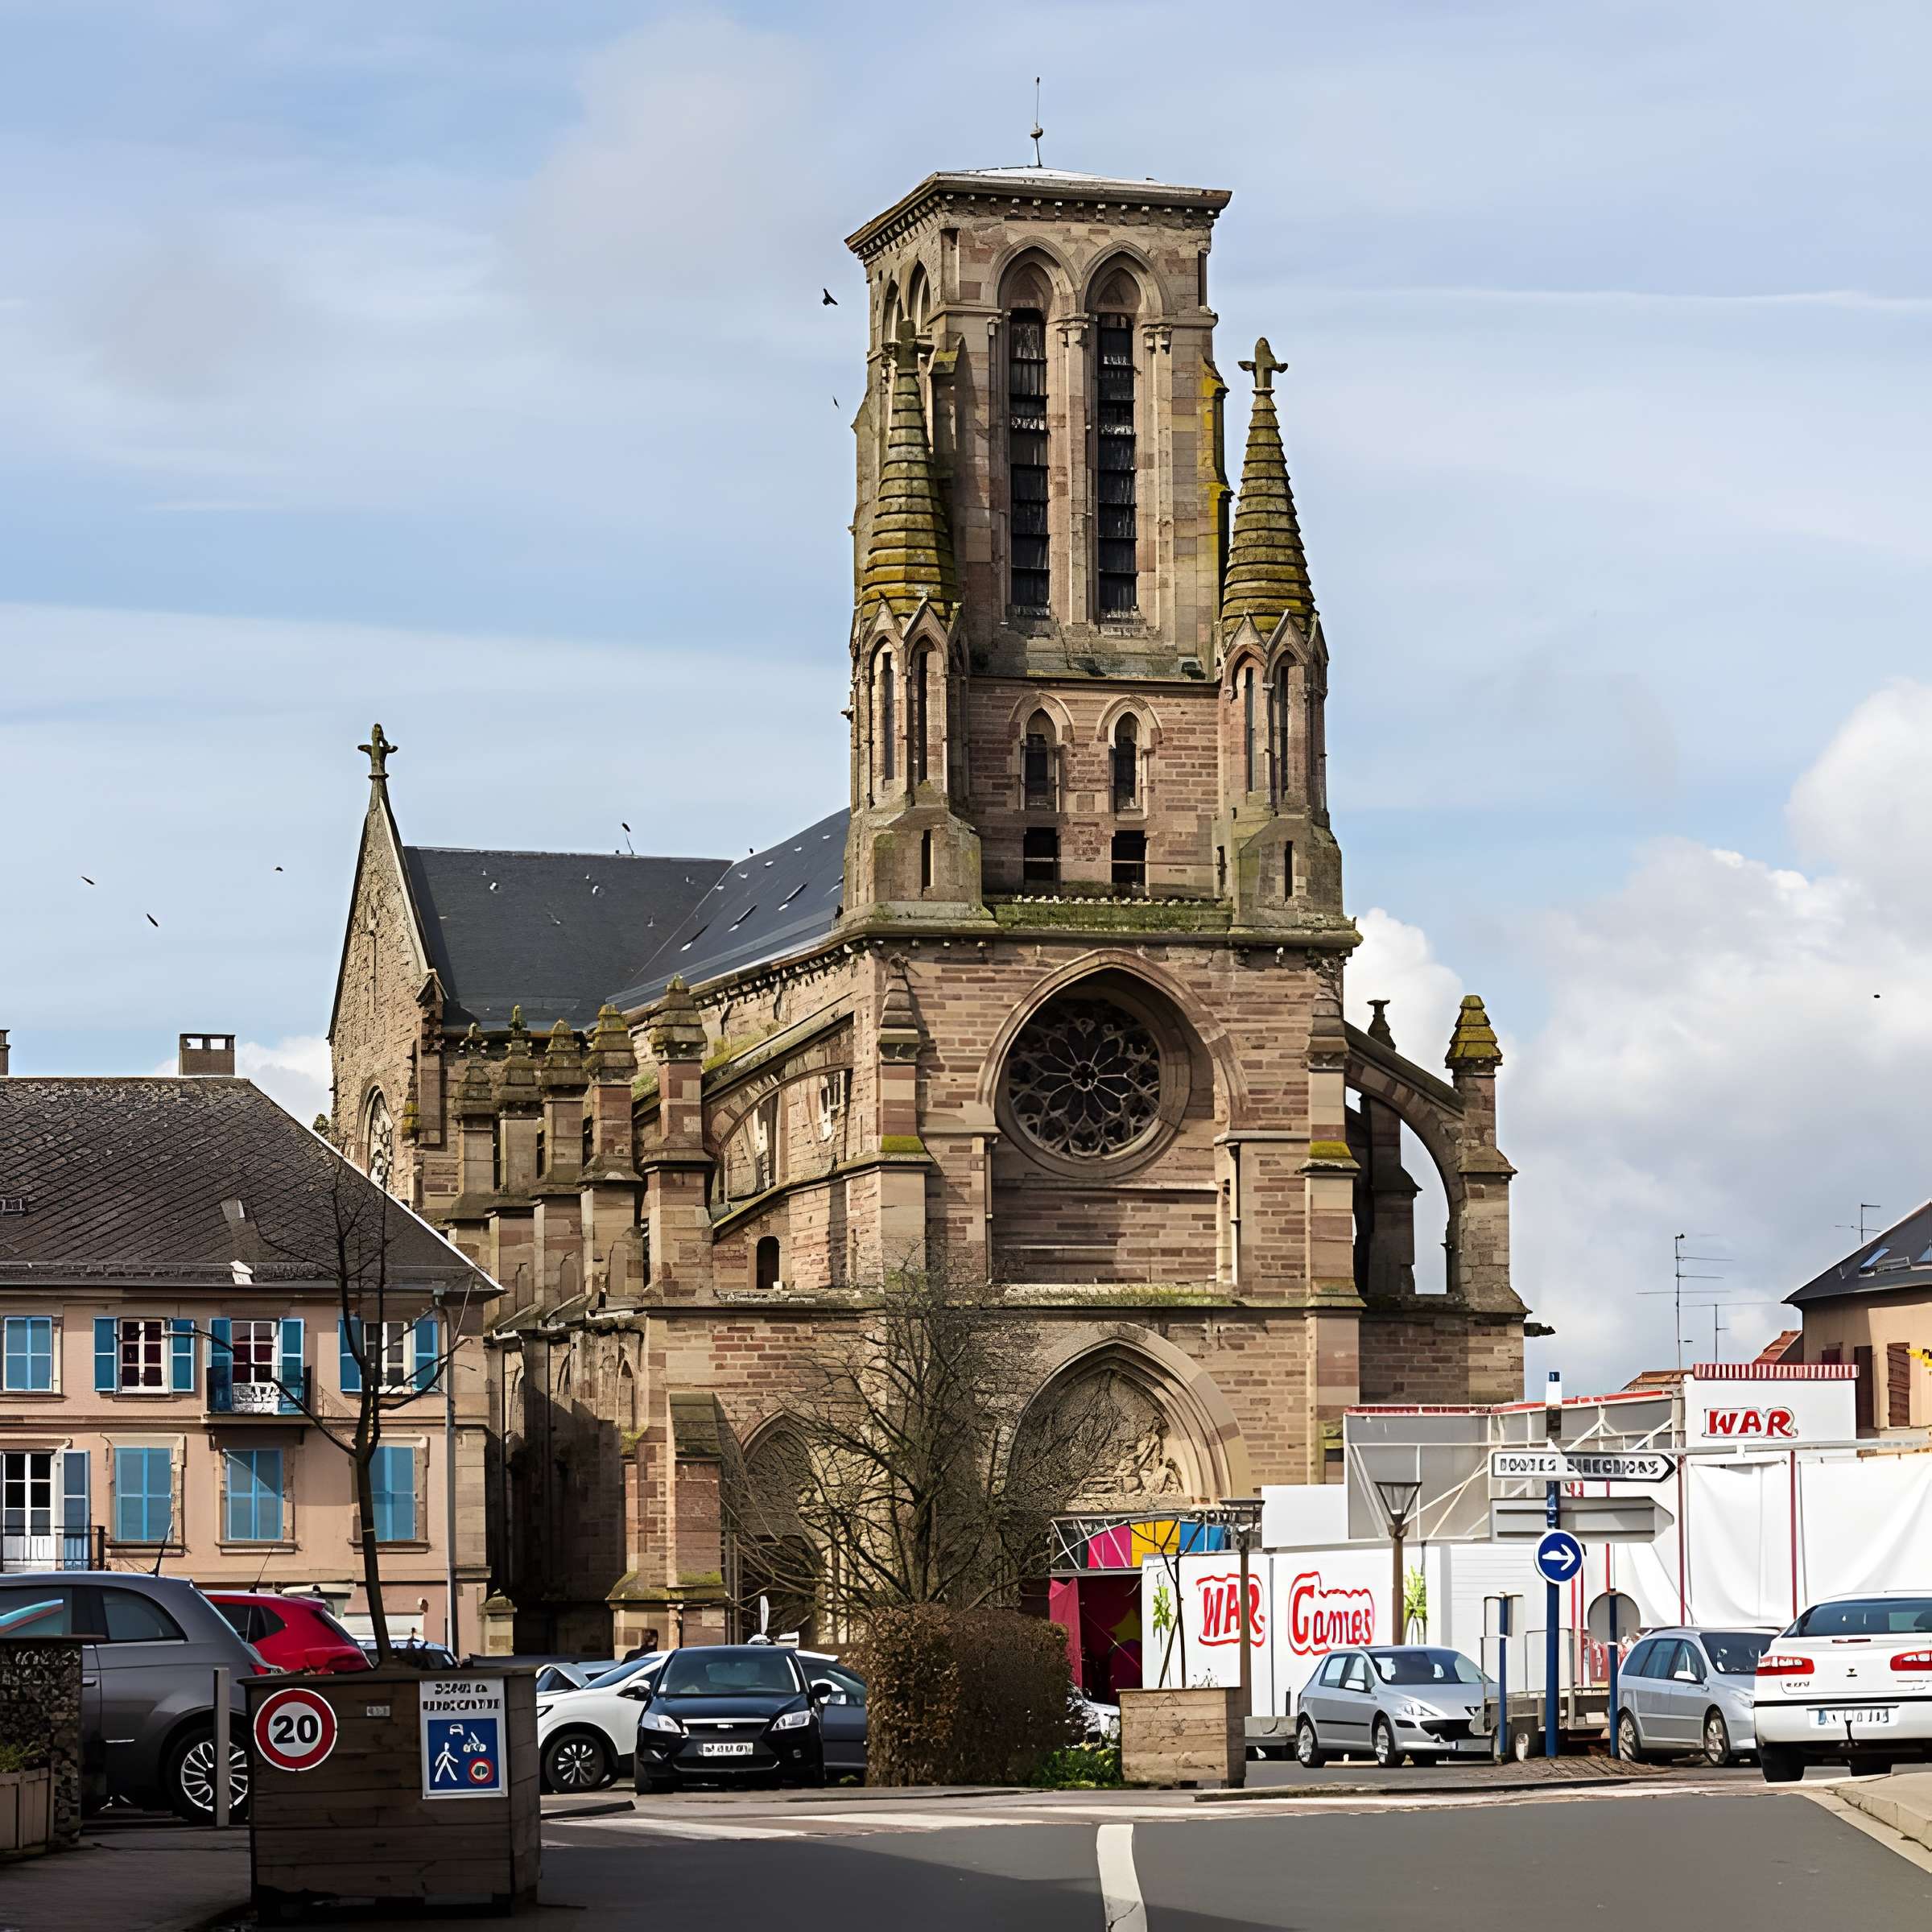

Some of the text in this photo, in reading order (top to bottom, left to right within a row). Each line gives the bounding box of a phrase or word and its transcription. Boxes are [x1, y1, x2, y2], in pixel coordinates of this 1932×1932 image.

[1708, 1409, 1793, 1437] WAR
[1203, 1583, 1373, 1645] WAR Games
[273, 1715, 319, 1744] 20
